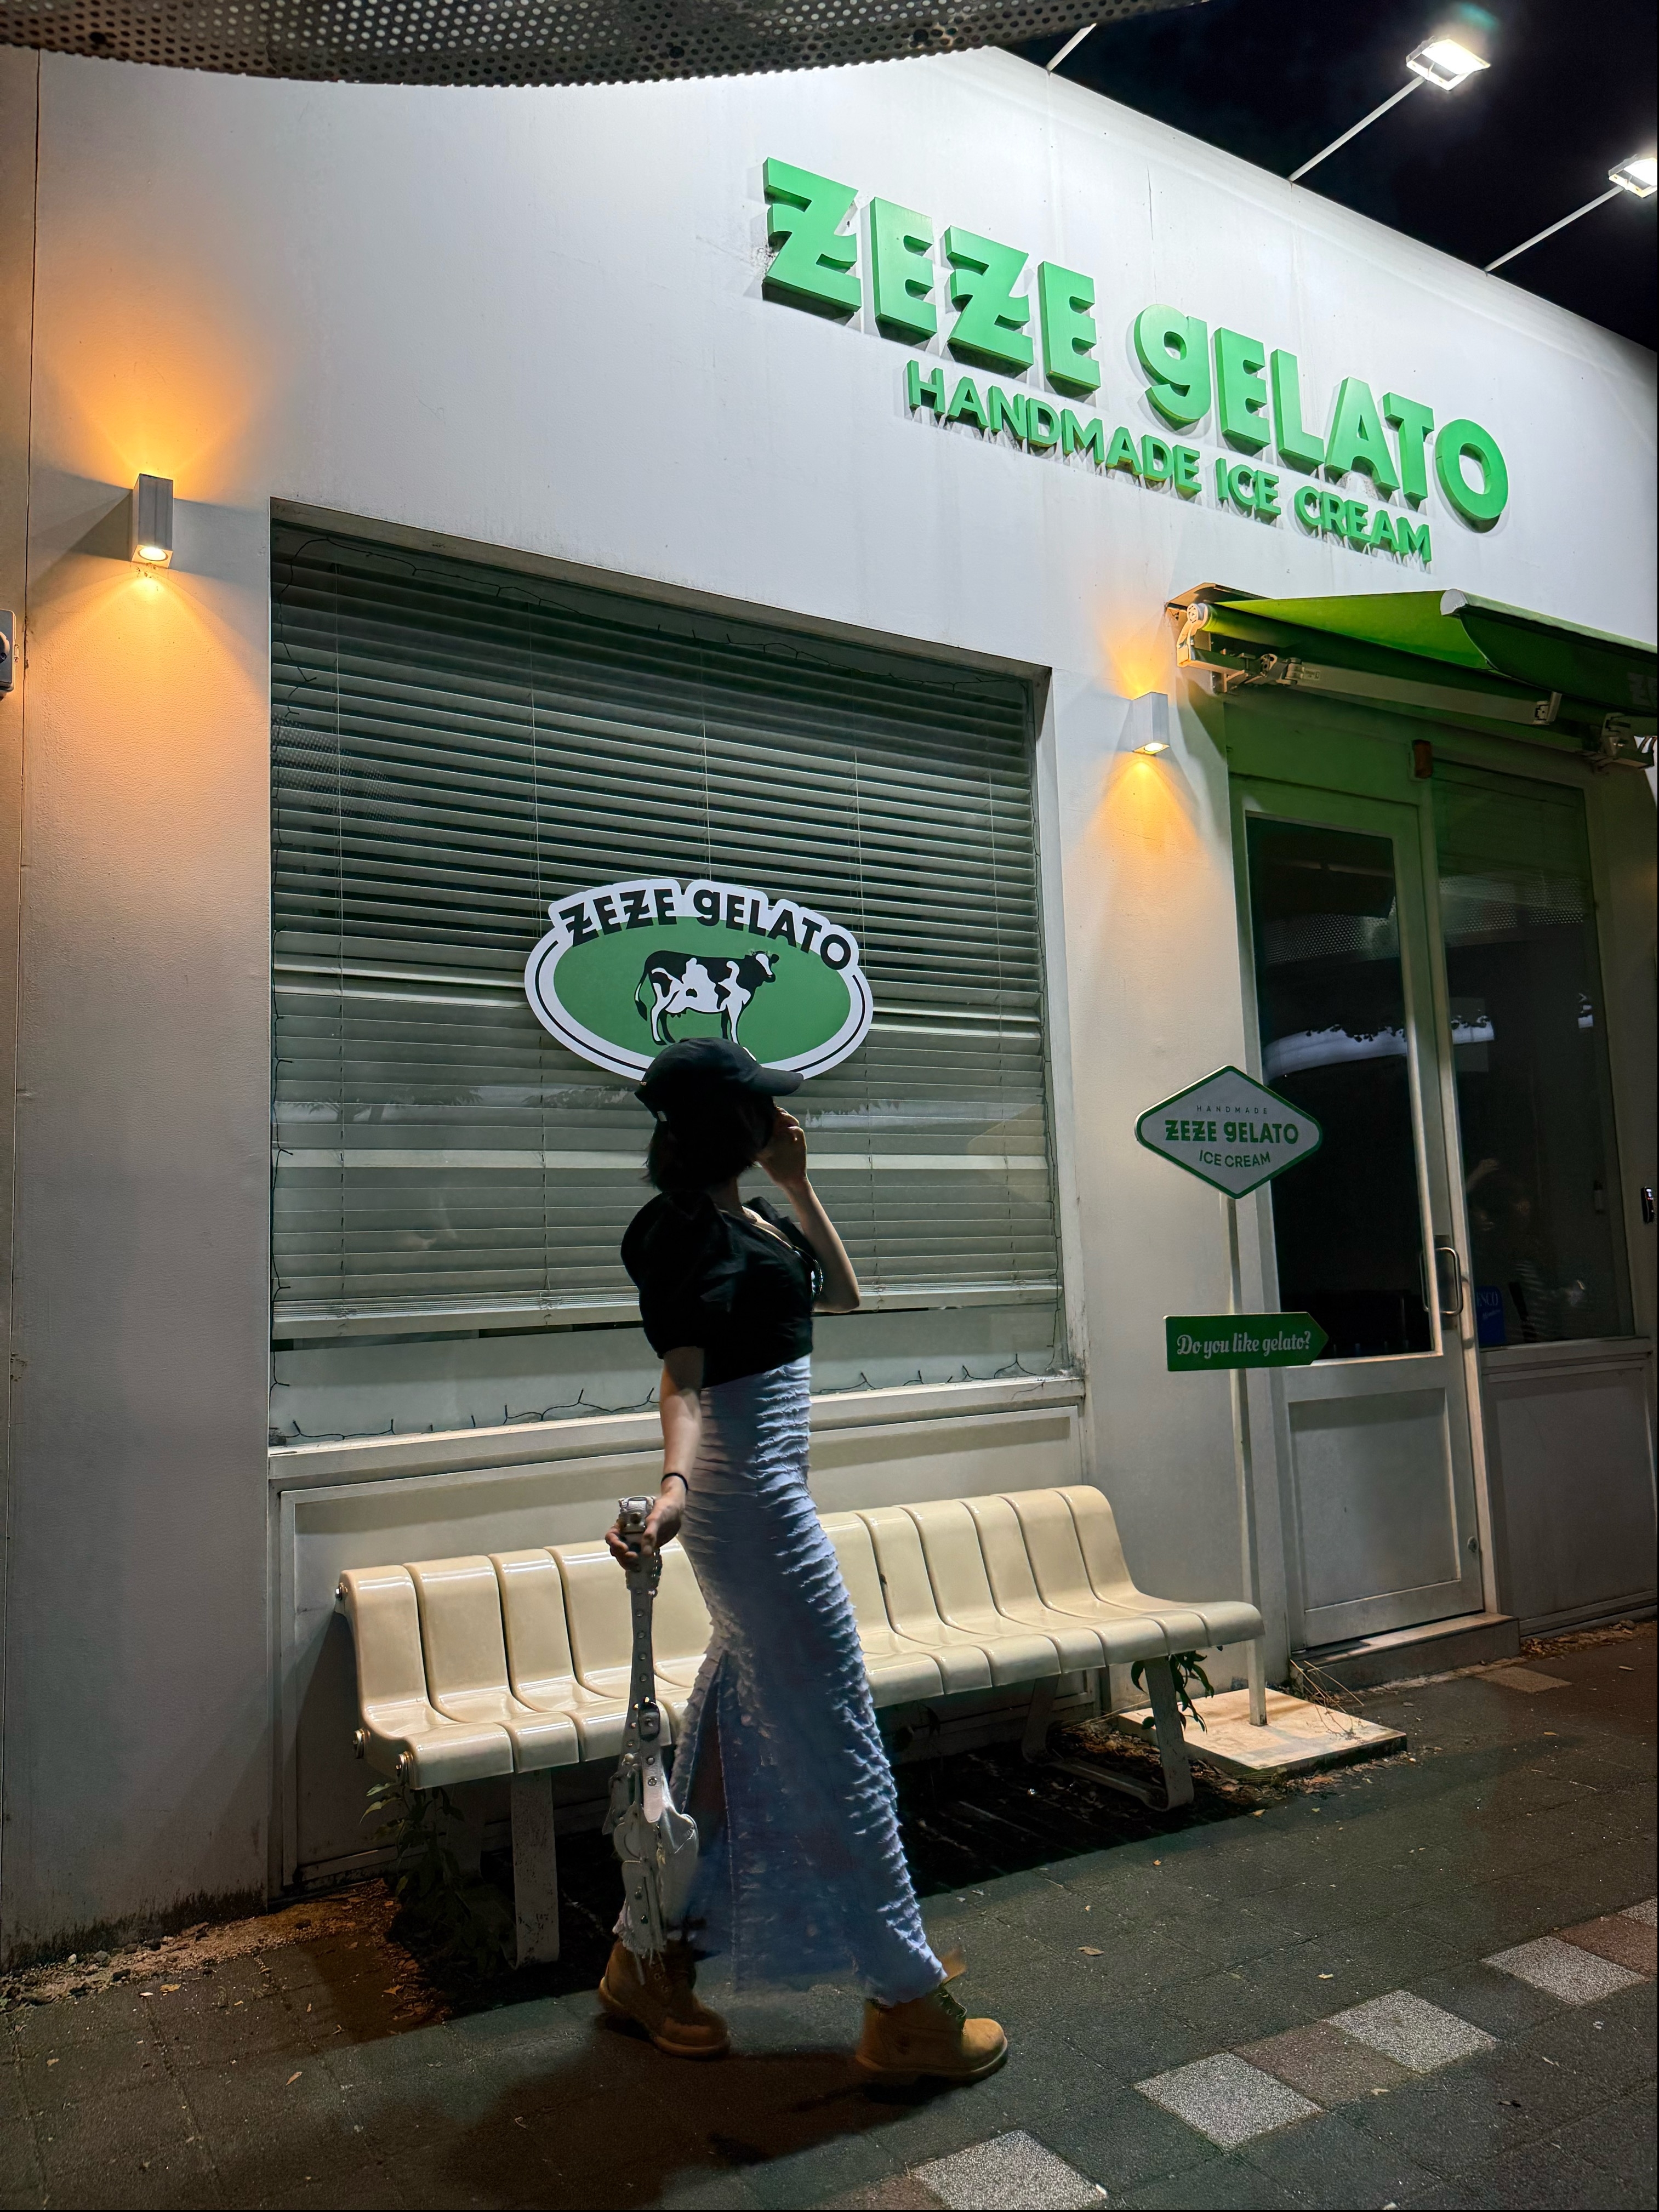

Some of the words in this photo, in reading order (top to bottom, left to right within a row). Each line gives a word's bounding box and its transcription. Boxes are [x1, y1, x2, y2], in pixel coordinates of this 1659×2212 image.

[762, 157, 1102, 392] ZEZE
[908, 360, 1202, 494] HANDMADE
[1216, 458, 1281, 516] ICE
[1294, 487, 1432, 563] CREAM
[559, 888, 677, 947] ZEZE
[1197, 1105, 1268, 1114] HANDMADE
[1165, 1120, 1217, 1142] ZEZE
[1199, 1149, 1222, 1166] ICE
[1224, 1151, 1271, 1167] CREAM
[1177, 1335, 1202, 1355] Do
[1204, 1341, 1230, 1359] you
[1233, 1332, 1259, 1353] like
[1262, 1330, 1312, 1357] gelato?
